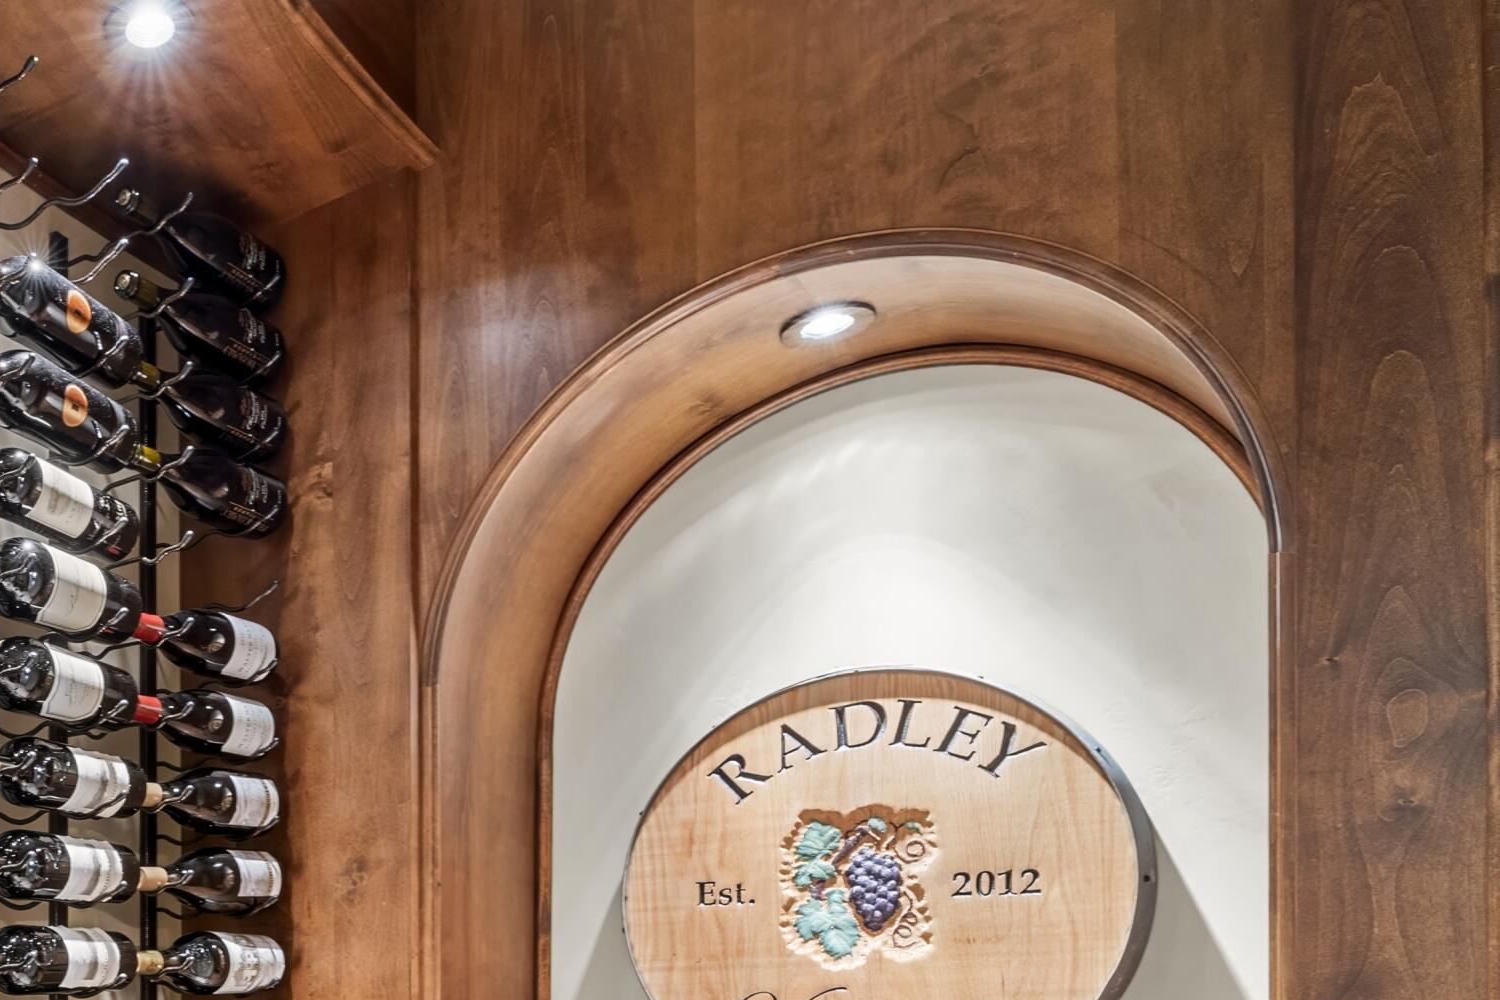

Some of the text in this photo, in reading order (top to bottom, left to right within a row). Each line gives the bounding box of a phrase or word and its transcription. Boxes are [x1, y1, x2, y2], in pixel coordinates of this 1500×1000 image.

[707, 698, 1047, 806] RADLEY
[695, 868, 1043, 907] Est. 2012
